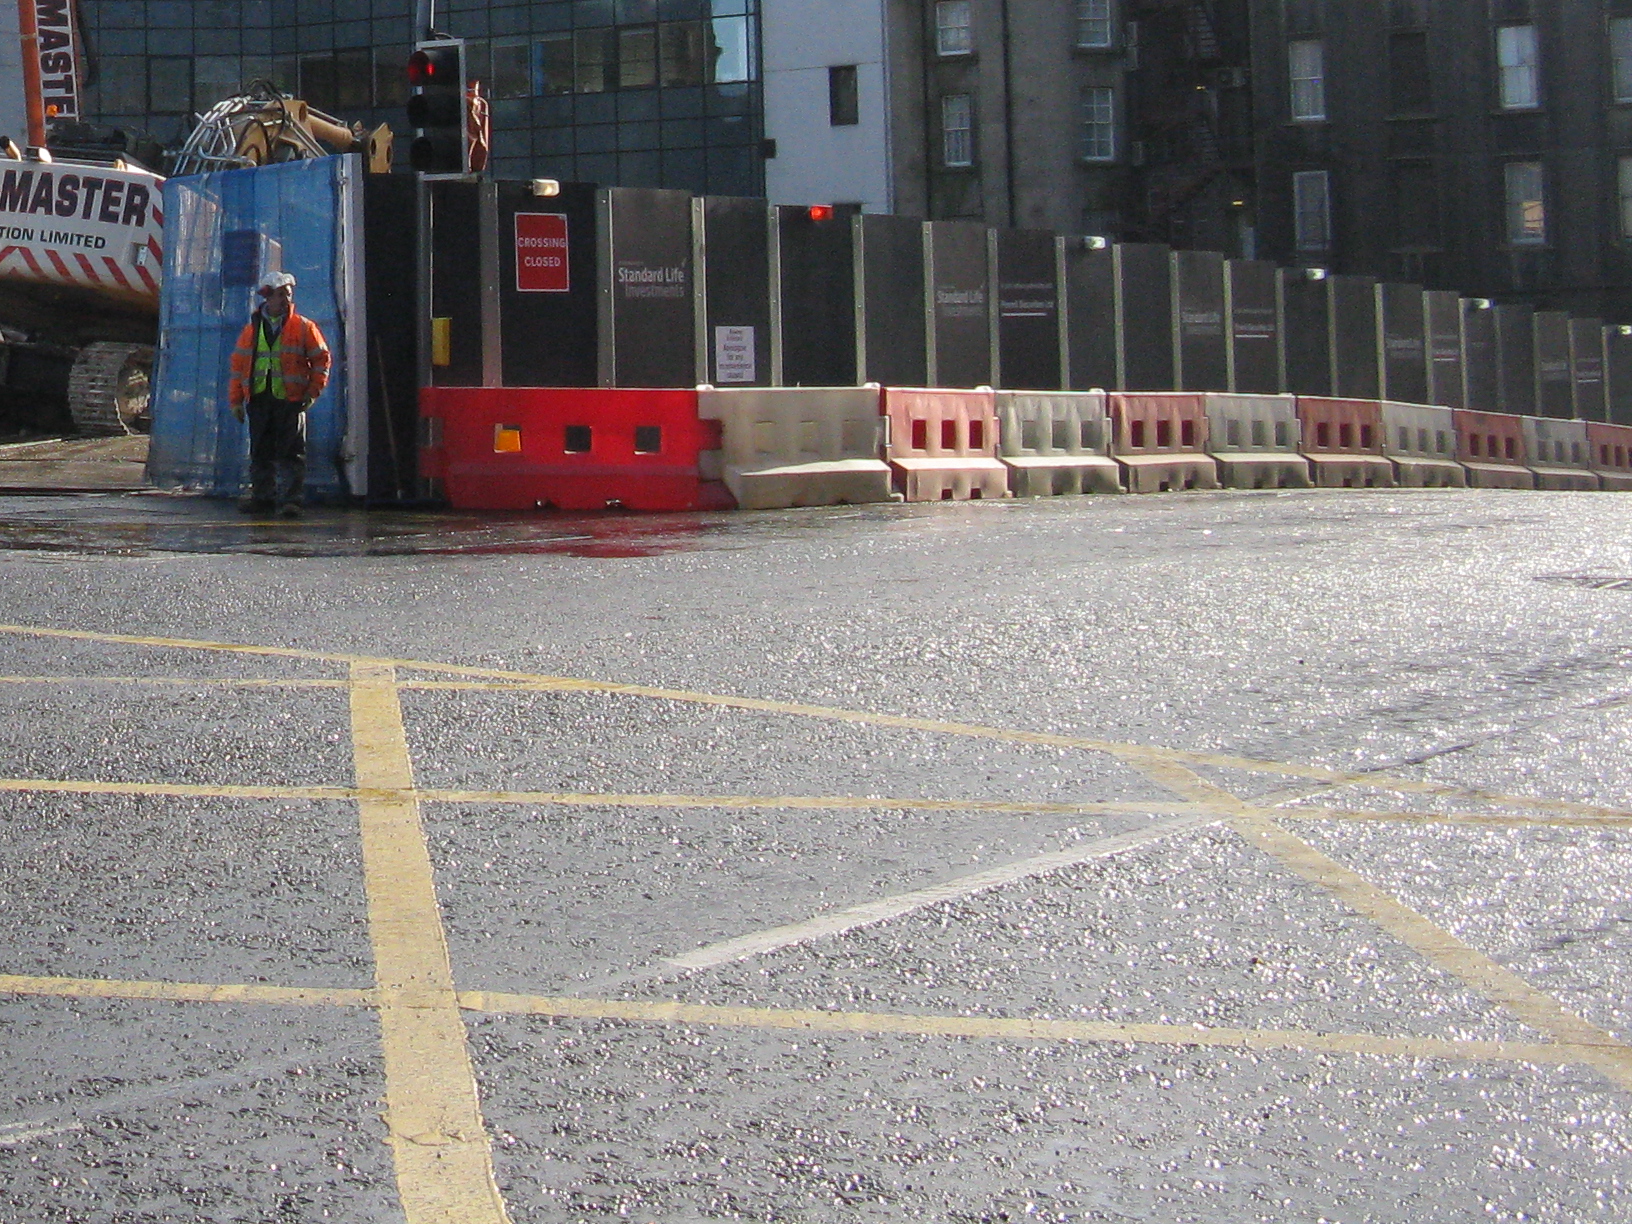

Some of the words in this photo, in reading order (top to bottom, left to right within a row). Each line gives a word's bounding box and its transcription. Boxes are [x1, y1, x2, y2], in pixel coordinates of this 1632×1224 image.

[40, 229, 106, 249] LIMITED
[518, 237, 566, 248] CROSSING
[524, 256, 561, 267] CLOSED
[618, 267, 663, 282] Standard
[665, 267, 684, 282] Life
